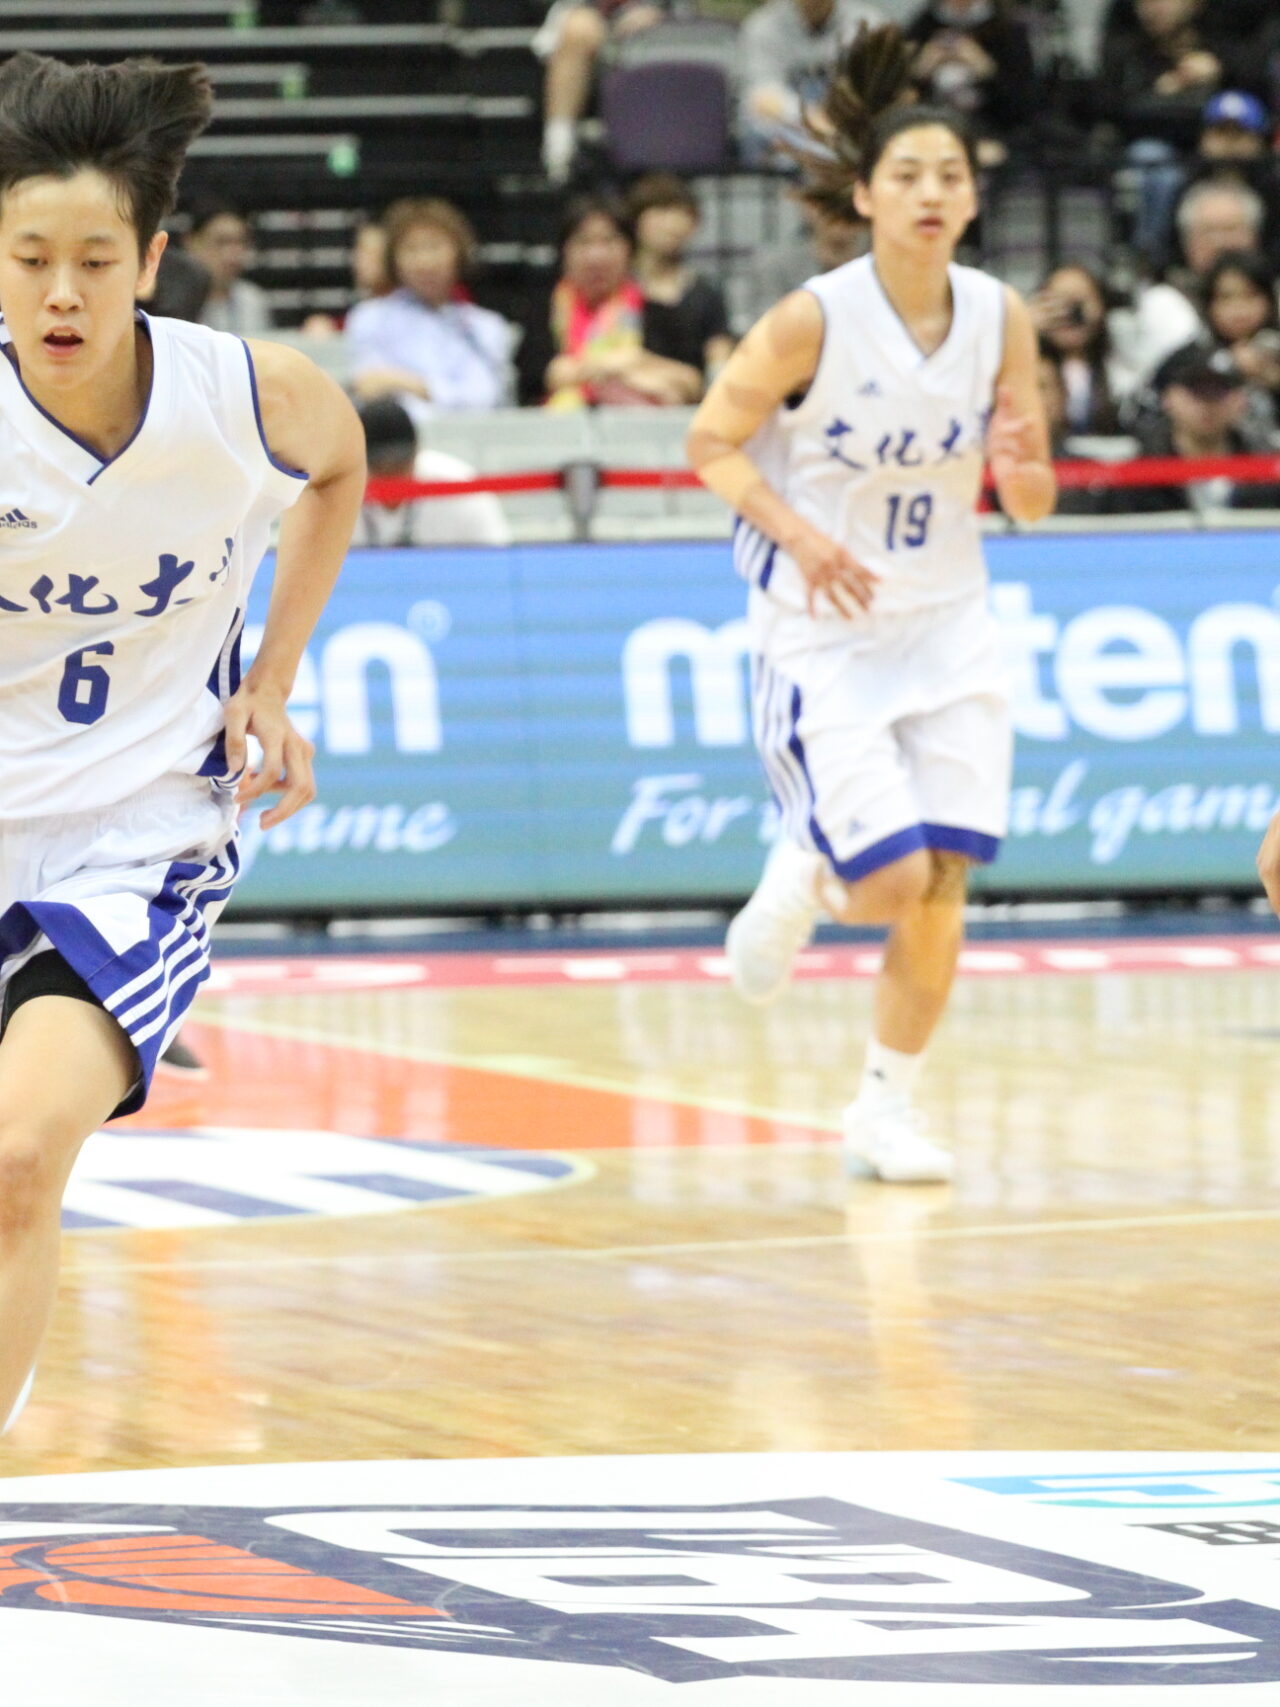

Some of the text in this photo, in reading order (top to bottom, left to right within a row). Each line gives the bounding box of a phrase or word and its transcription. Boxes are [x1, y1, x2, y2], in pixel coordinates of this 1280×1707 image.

[824, 405, 993, 471] 文化大
[885, 491, 933, 551] 19
[57, 640, 115, 726] 6
[609, 773, 752, 855] For
[1088, 782, 1280, 865] gam
